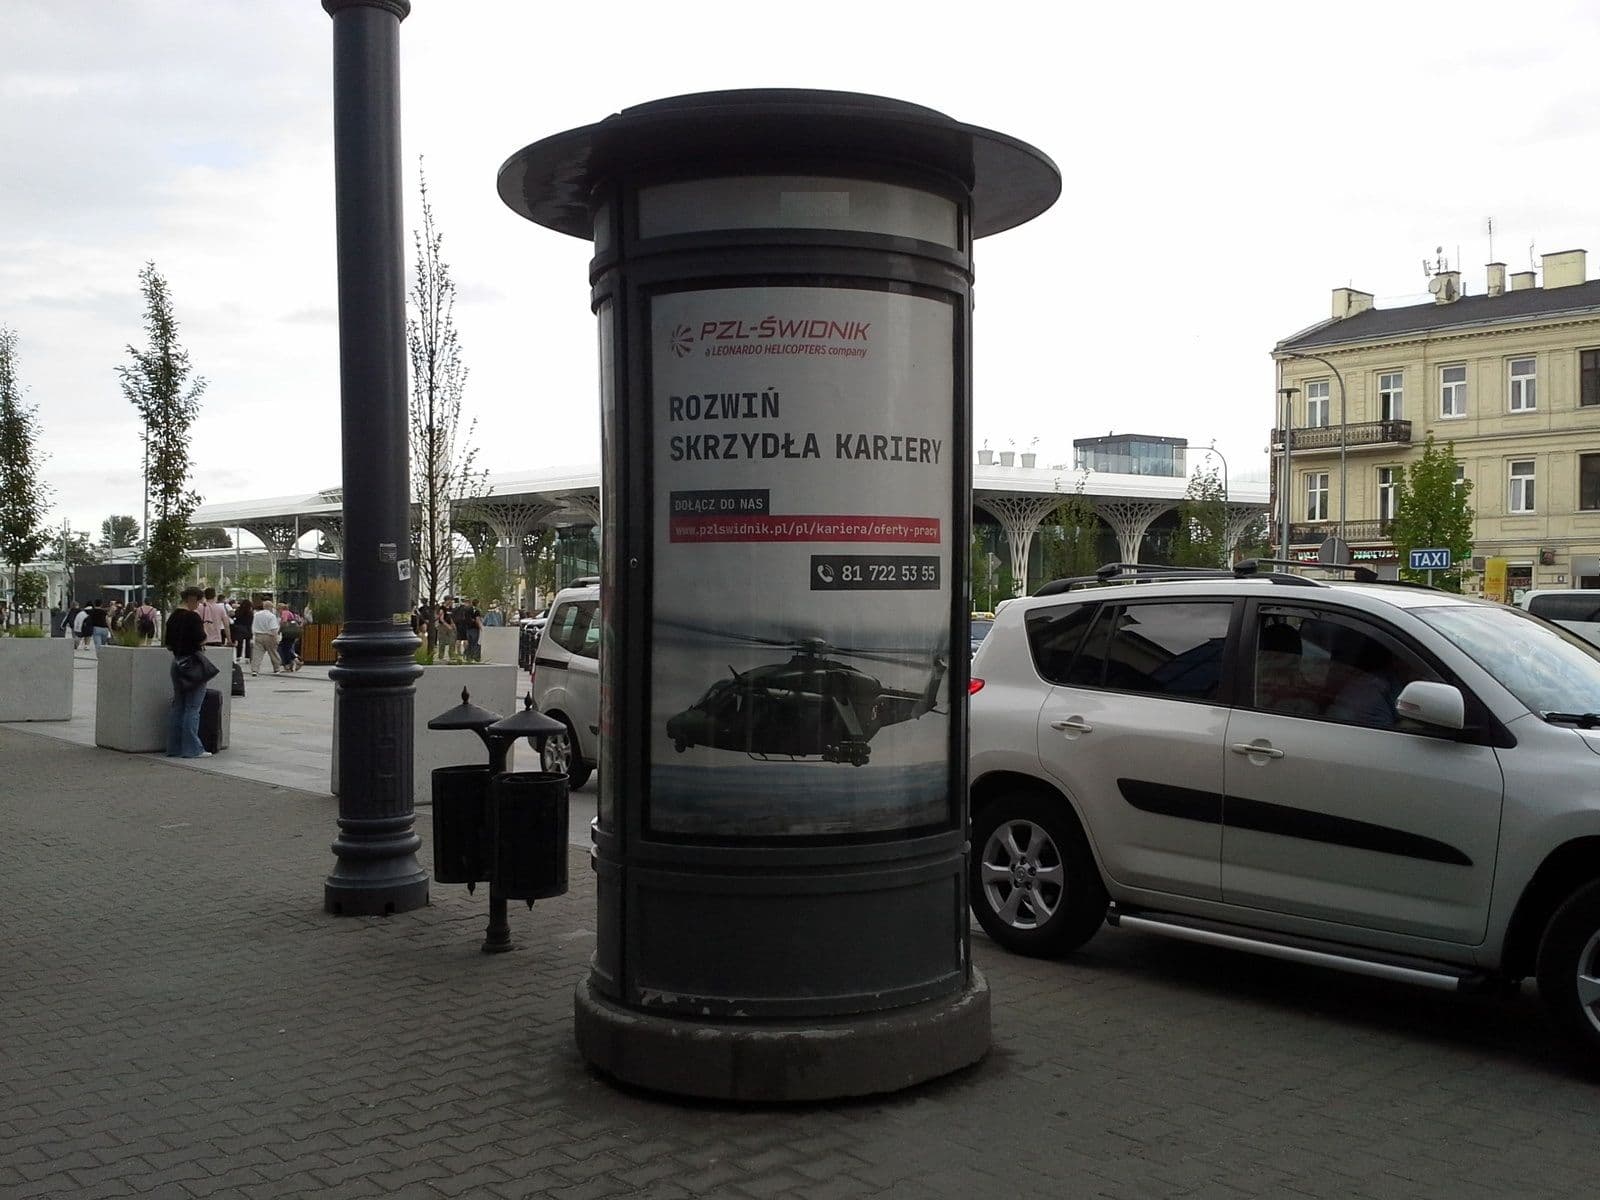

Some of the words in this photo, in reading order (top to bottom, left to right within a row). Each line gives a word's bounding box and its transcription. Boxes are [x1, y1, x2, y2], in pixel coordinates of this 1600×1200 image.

[700, 315, 871, 341] PZL-ŚWIDNIK
[712, 344, 763, 356] LEONARDO
[764, 343, 827, 355] HELICOPTERS
[828, 347, 868, 358] company
[669, 386, 780, 421] ROZWIŃ
[670, 433, 821, 462] SKRZYDŁA
[835, 434, 942, 464] KARIERY
[675, 500, 715, 512] DOŁĄCZ
[720, 499, 735, 510] DO
[740, 499, 763, 509] NAS
[675, 522, 938, 537] www.pzlswidnik.pl/pl/kariera/oferty-pracy
[1412, 552, 1447, 567] TAXI
[842, 565, 863, 581] 81
[869, 565, 897, 581] 722
[902, 566, 918, 581] 53
[921, 566, 936, 581] 55
